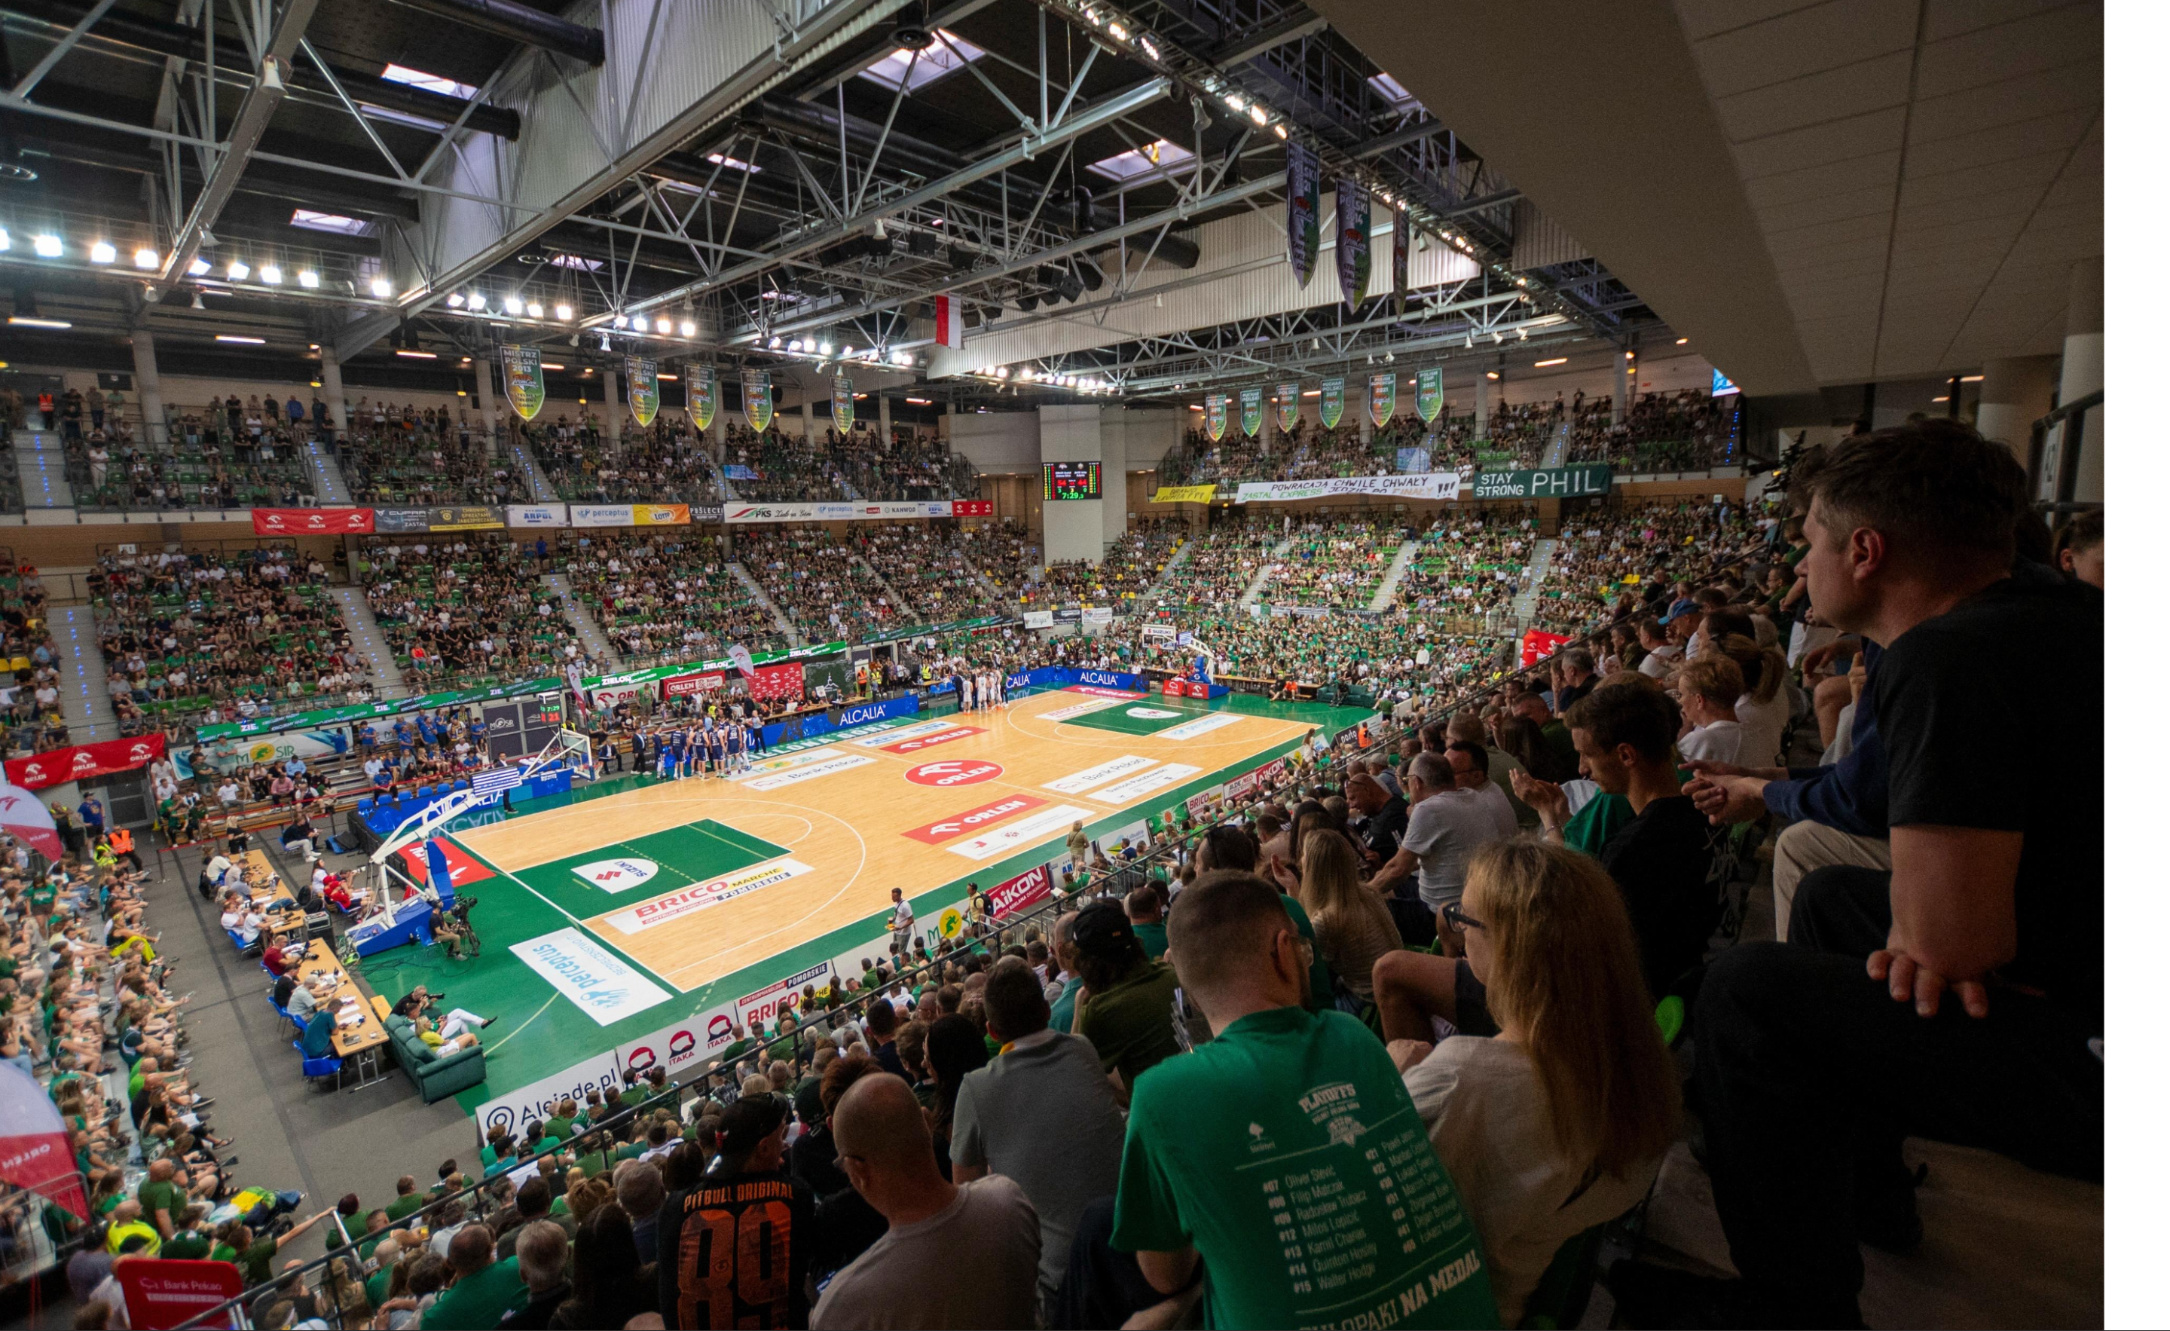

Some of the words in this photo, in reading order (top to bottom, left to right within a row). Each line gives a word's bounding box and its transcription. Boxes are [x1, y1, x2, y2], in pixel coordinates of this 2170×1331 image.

[503, 349, 537, 359] MISTRZ
[504, 356, 538, 366] POLSKI
[512, 365, 532, 373] 2013
[627, 361, 655, 370] MISTRZ
[1334, 479, 1378, 488] CHWILE
[1480, 472, 1514, 485] STAY
[1531, 470, 1601, 495] PHIL
[1242, 491, 1274, 500] ZASTAL
[1279, 488, 1322, 498] EXPRESS
[1476, 484, 1524, 497] STRONG
[592, 509, 628, 517] perceptus
[755, 510, 772, 518] PKS
[1080, 672, 1118, 686] ALCALIA
[669, 684, 695, 692] ORLEN
[548, 713, 560, 722] 21
[839, 705, 886, 726] ALCALIA
[925, 729, 973, 743] ORLEN
[129, 752, 153, 762] ORLEN
[72, 762, 97, 772] ORLEN
[24, 773, 47, 783] ORLEN
[936, 765, 998, 785] ORLEN
[1190, 793, 1209, 810] BRICO
[963, 800, 1027, 823] ORLEN
[723, 873, 787, 898] POMORSKIE
[992, 868, 1044, 915] AiKON
[635, 881, 728, 918] BRICO
[532, 944, 606, 989] perceptus
[788, 964, 826, 987] POMORSKIE
[707, 1034, 732, 1049] ITAKA
[668, 1050, 695, 1066] ITAKA
[1298, 1083, 1357, 1114] PLAYOFFS
[683, 1186, 733, 1213] PITBULL
[737, 1180, 794, 1202] ORIGINAL
[1279, 1228, 1297, 1242] #12
[1307, 1237, 1335, 1255] Kamil
[677, 1200, 791, 1330] 89
[1289, 1262, 1307, 1276] #14
[164, 1280, 189, 1290] Bank
[191, 1280, 222, 1291] Pekao
[1399, 1282, 1429, 1317] NA
[1428, 1248, 1481, 1297] MEDAL
